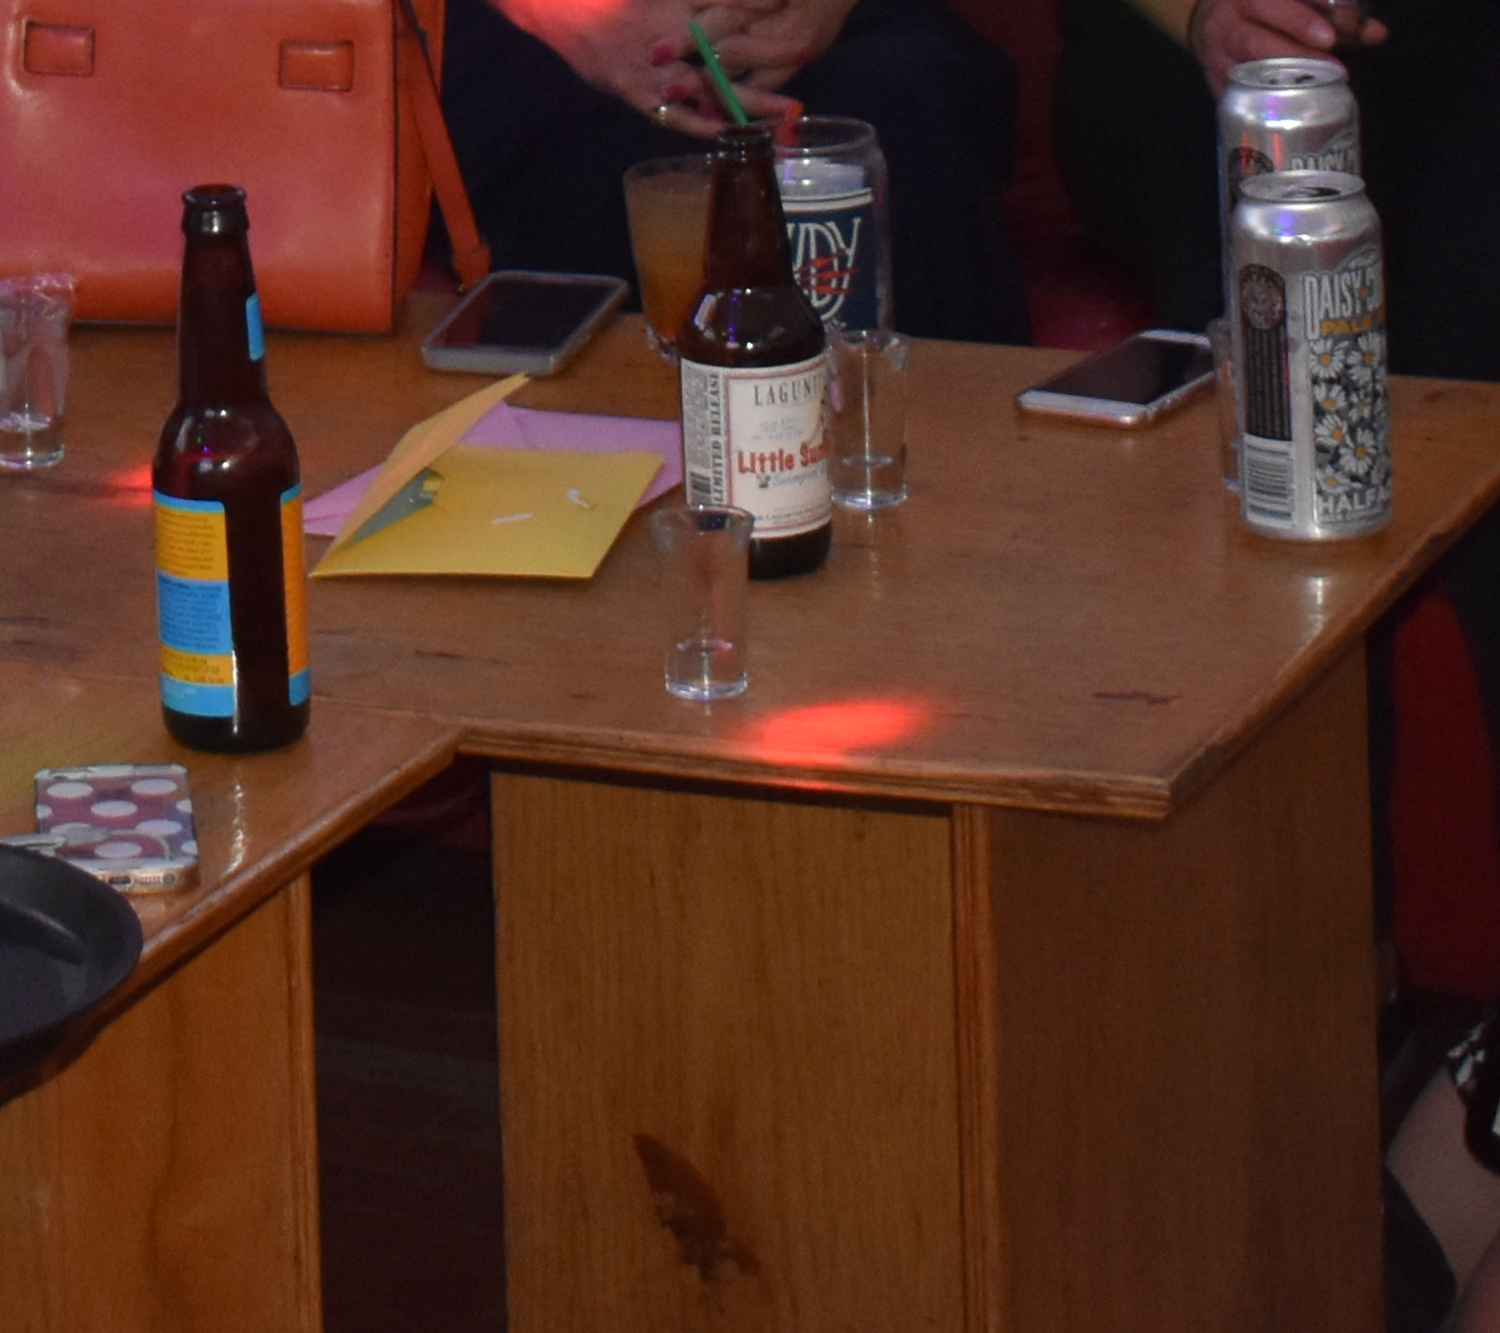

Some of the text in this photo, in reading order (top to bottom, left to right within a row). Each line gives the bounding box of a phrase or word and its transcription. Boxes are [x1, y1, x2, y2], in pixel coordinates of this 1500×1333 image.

[709, 373, 725, 504] LIMITED RELEASE
[738, 448, 796, 474] Little
